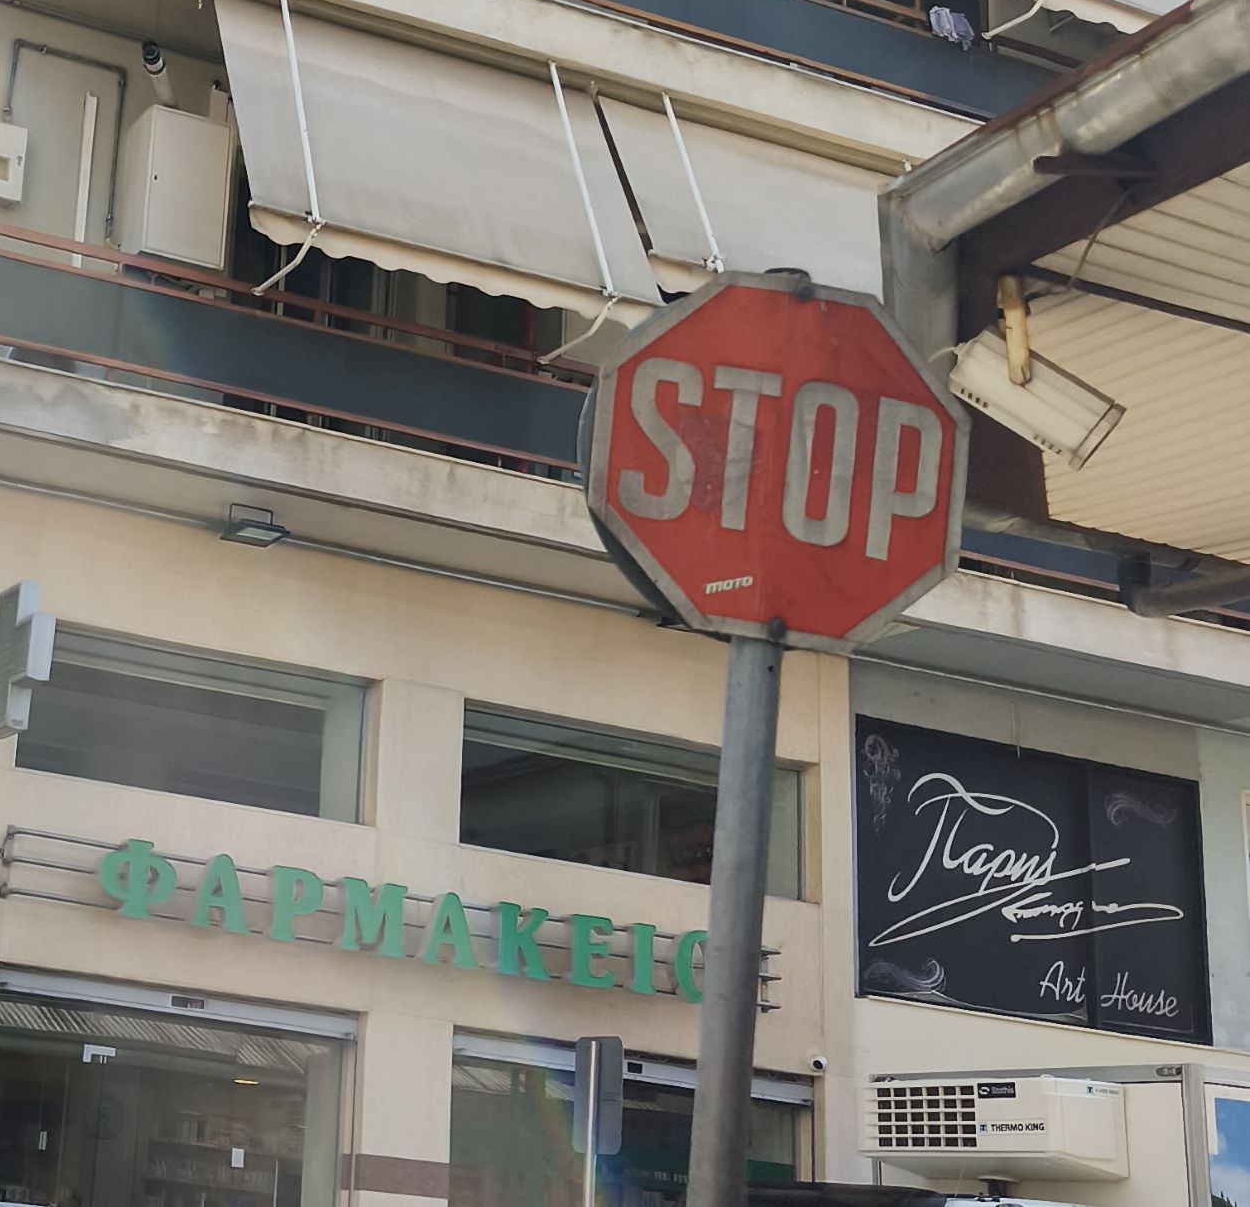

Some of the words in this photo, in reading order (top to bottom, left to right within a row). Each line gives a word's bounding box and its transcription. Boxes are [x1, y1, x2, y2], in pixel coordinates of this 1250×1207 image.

[617, 357, 943, 561] STOP
[1039, 959, 1086, 1004] Art
[1101, 971, 1179, 1018] House
[990, 1123, 1024, 1132] THERMO
[1025, 1122, 1046, 1131] KING
